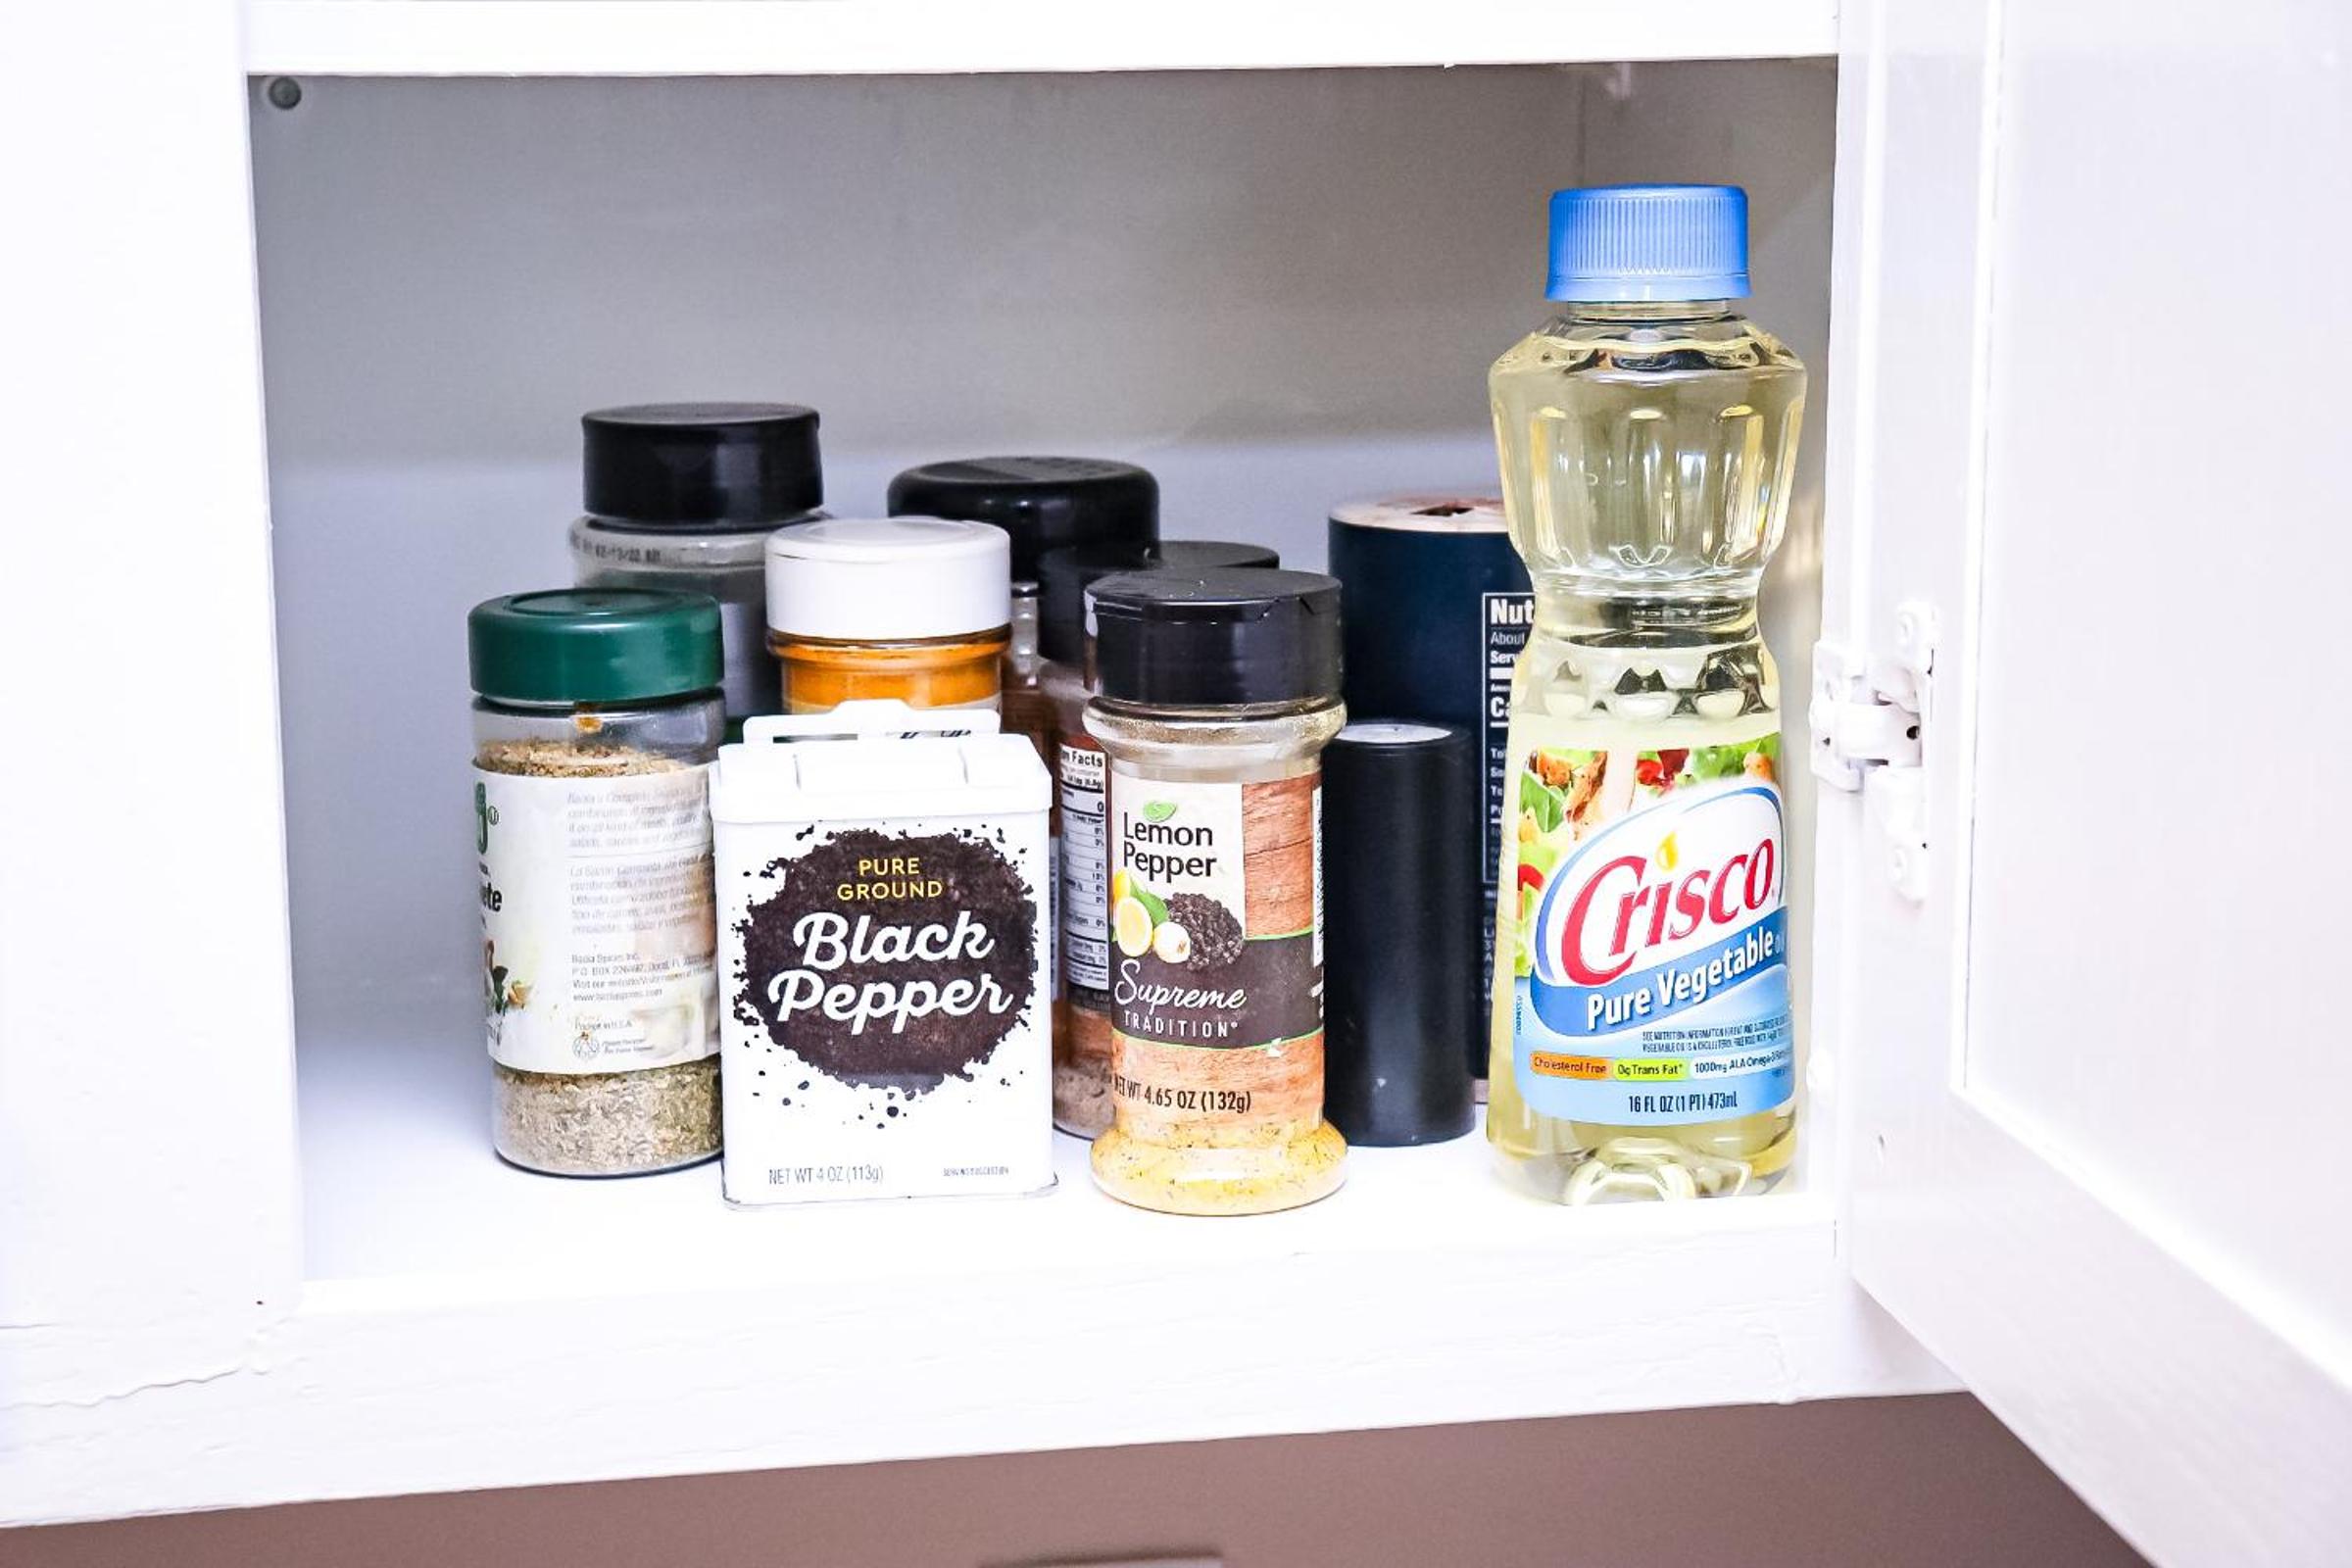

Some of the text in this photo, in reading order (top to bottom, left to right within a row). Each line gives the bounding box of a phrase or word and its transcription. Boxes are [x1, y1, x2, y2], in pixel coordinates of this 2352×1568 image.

[1072, 751, 1102, 767] Facts
[1123, 811, 1213, 847] Lemon
[858, 858, 920, 875] PURE
[1123, 840, 1217, 883] Pepper
[837, 882, 943, 901] GROUND
[1561, 838, 1774, 987] Crisco
[793, 910, 995, 970] Black
[1114, 958, 1248, 1015] Supreme
[1587, 986, 1651, 1030] Pure
[1657, 926, 1773, 1007] Vegetable
[767, 969, 1014, 1035] Pepper
[1124, 1010, 1230, 1038] TRADITION
[1534, 1056, 1606, 1073] Cholesterol Free
[1618, 1064, 1631, 1075] 0g
[1632, 1064, 1660, 1075] Trans
[1694, 1062, 1727, 1073] 1000mg
[1729, 1058, 1745, 1069] ALA
[1127, 1080, 1142, 1101] WT
[1144, 1086, 1172, 1107] 4.65
[1177, 1091, 1197, 1109] OZ
[1201, 1091, 1251, 1114] (132g)
[1629, 1096, 1641, 1112] 16
[1644, 1096, 1656, 1112] FL
[1659, 1095, 1673, 1112] OZ
[769, 1164, 883, 1184] NET WT 4 OZ (113g)
